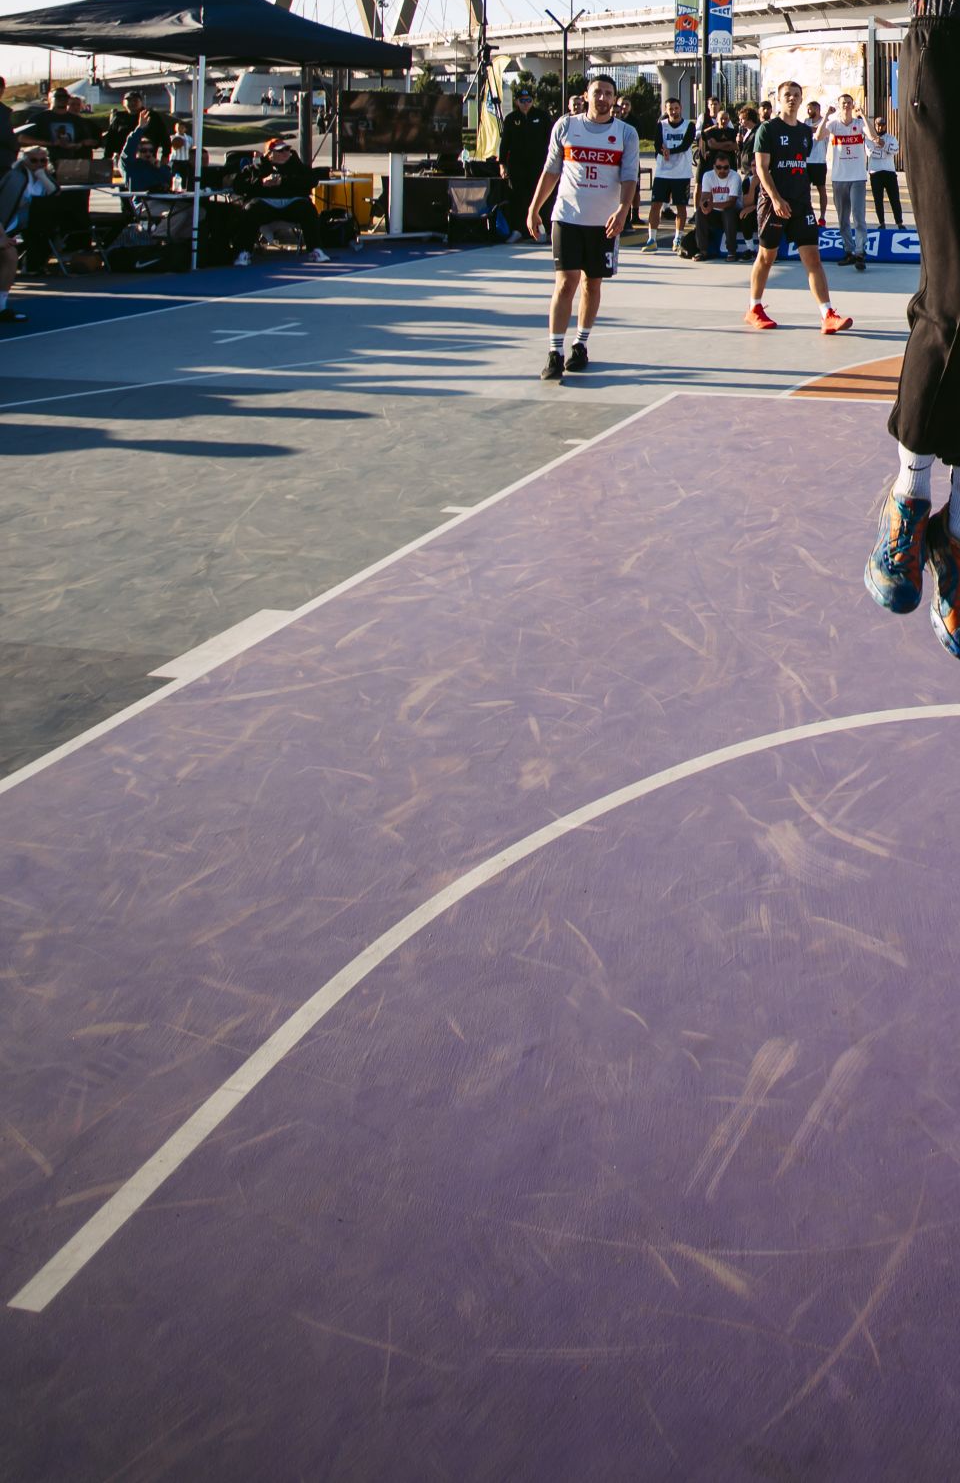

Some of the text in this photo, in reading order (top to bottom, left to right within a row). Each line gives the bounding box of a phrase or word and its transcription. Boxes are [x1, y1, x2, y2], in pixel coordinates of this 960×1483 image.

[676, 37, 698, 46] 29-30
[432, 122, 448, 132] 17
[779, 135, 789, 146] 12
[836, 136, 859, 144] KAREX
[569, 148, 615, 163] KAREX
[846, 146, 851, 155] 5
[585, 165, 598, 180] 15
[806, 214, 815, 226] 12
[605, 252, 613, 268] 3
